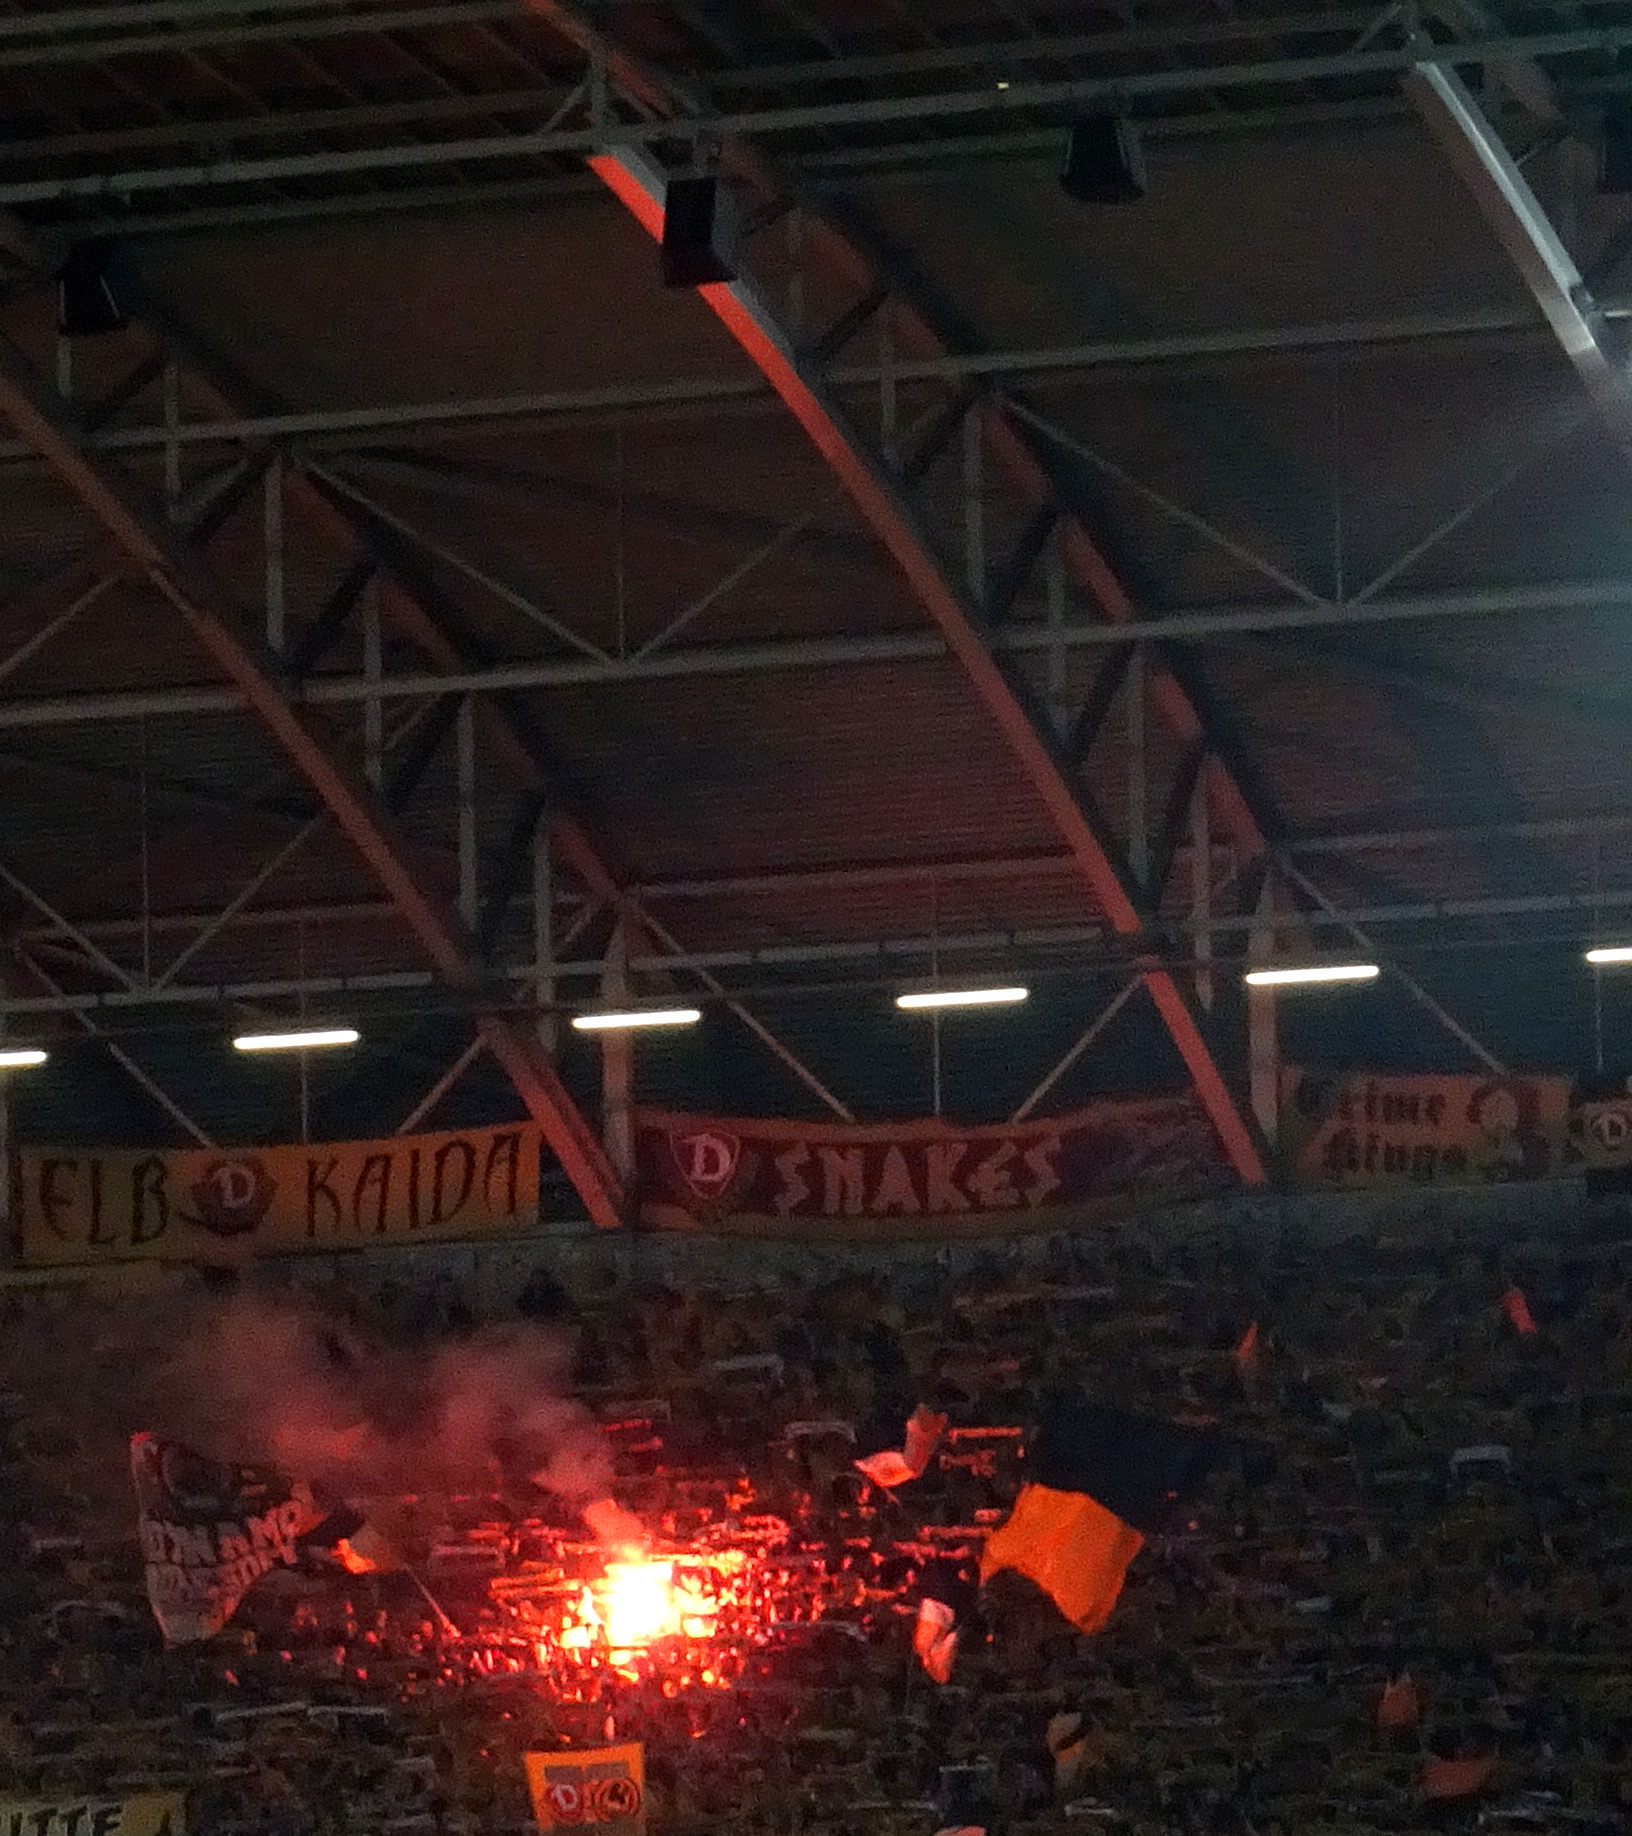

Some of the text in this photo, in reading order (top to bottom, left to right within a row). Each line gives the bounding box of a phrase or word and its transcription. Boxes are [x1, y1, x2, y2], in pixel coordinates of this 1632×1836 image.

[40, 1157, 171, 1246] ELB
[302, 1131, 523, 1237] KAIDA
[773, 1135, 1065, 1217] SNAKES
